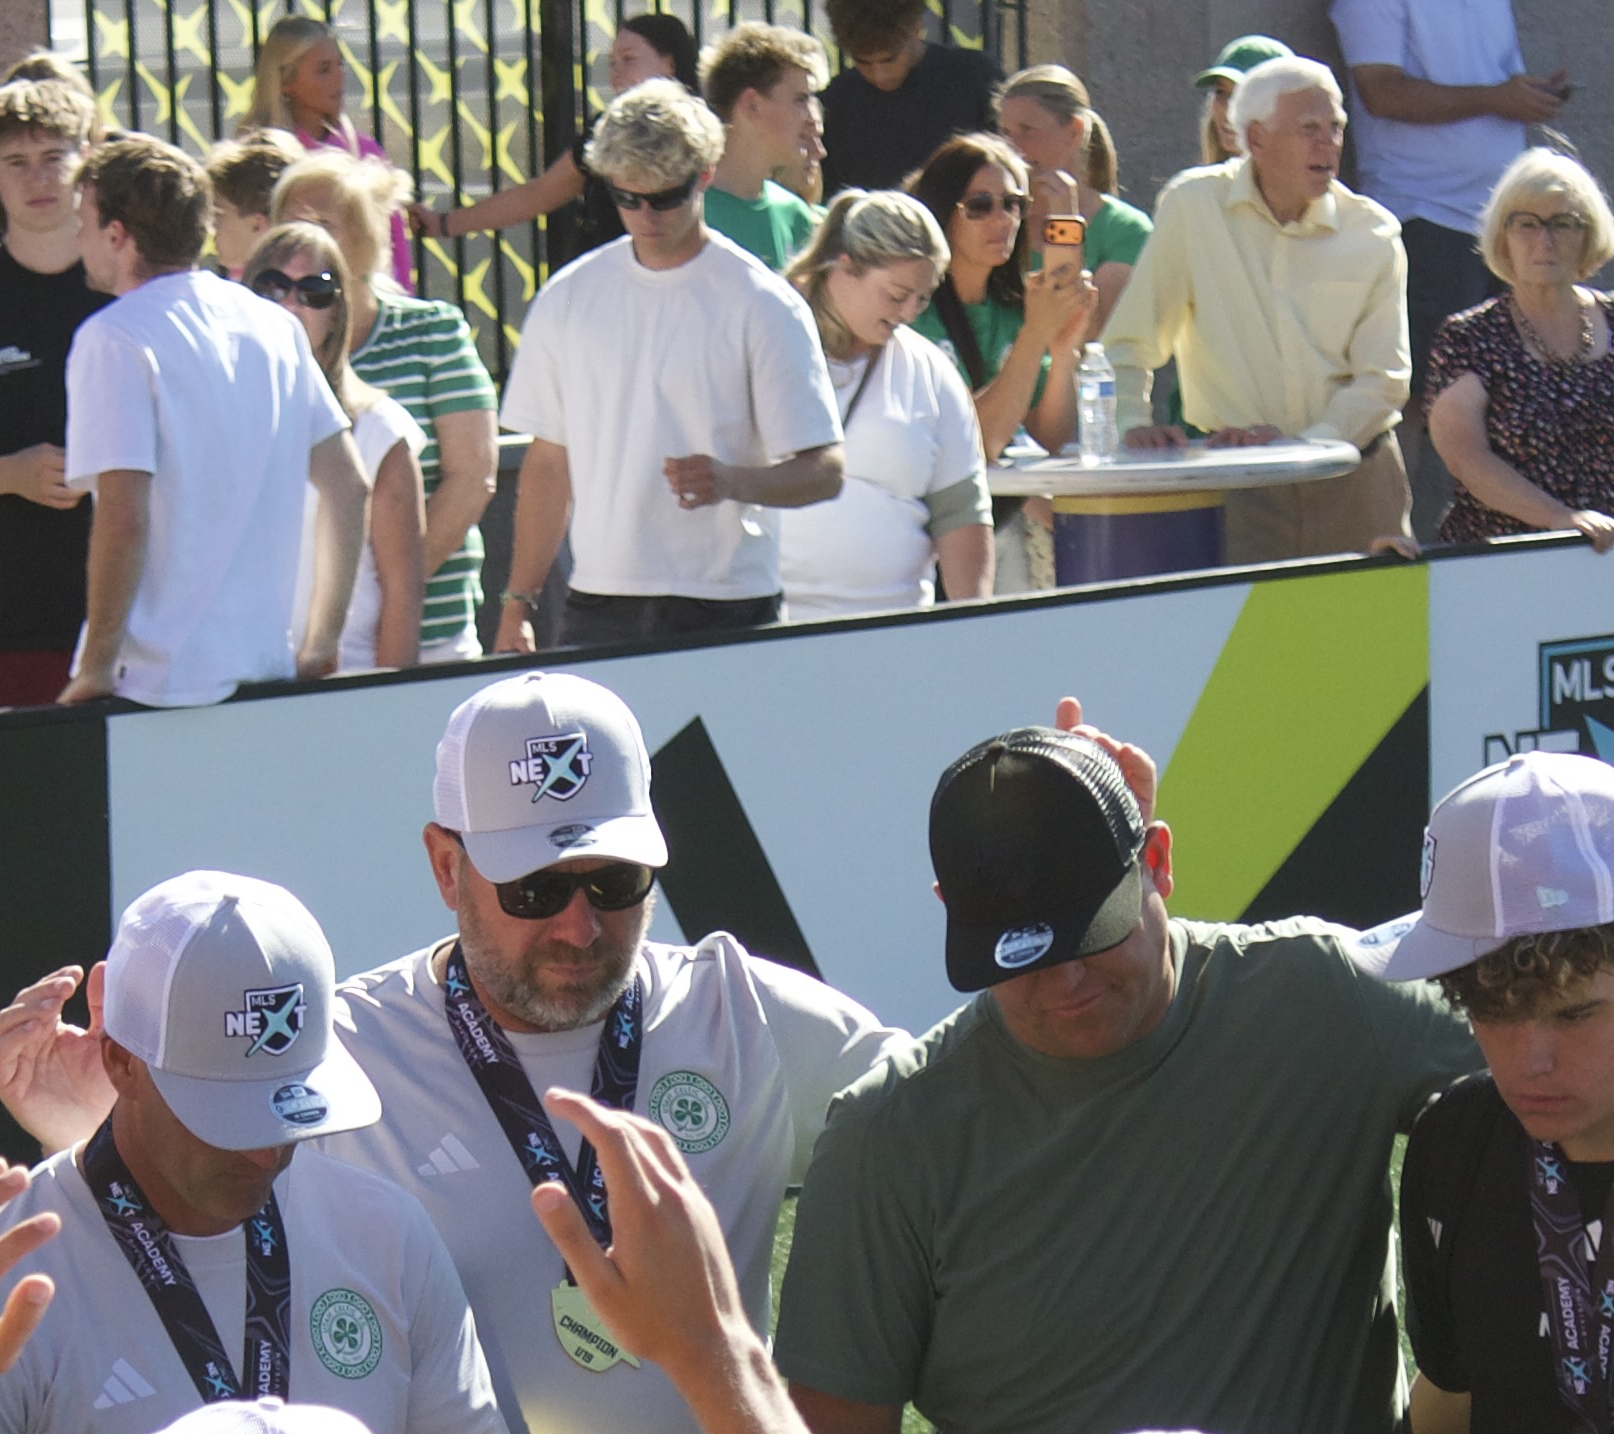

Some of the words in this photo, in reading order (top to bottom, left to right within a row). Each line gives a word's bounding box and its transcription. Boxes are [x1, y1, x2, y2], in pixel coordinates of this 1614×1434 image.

[508, 749, 593, 793] NEXT
[531, 741, 558, 754] MLS
[224, 997, 308, 1046] NEXT
[250, 993, 276, 1006] MLS
[457, 1002, 499, 1064] ACADEMY
[130, 1221, 178, 1286] ACADEMY
[558, 1314, 620, 1360] CHAMPION
[1558, 1277, 1580, 1350] ACADEMY
